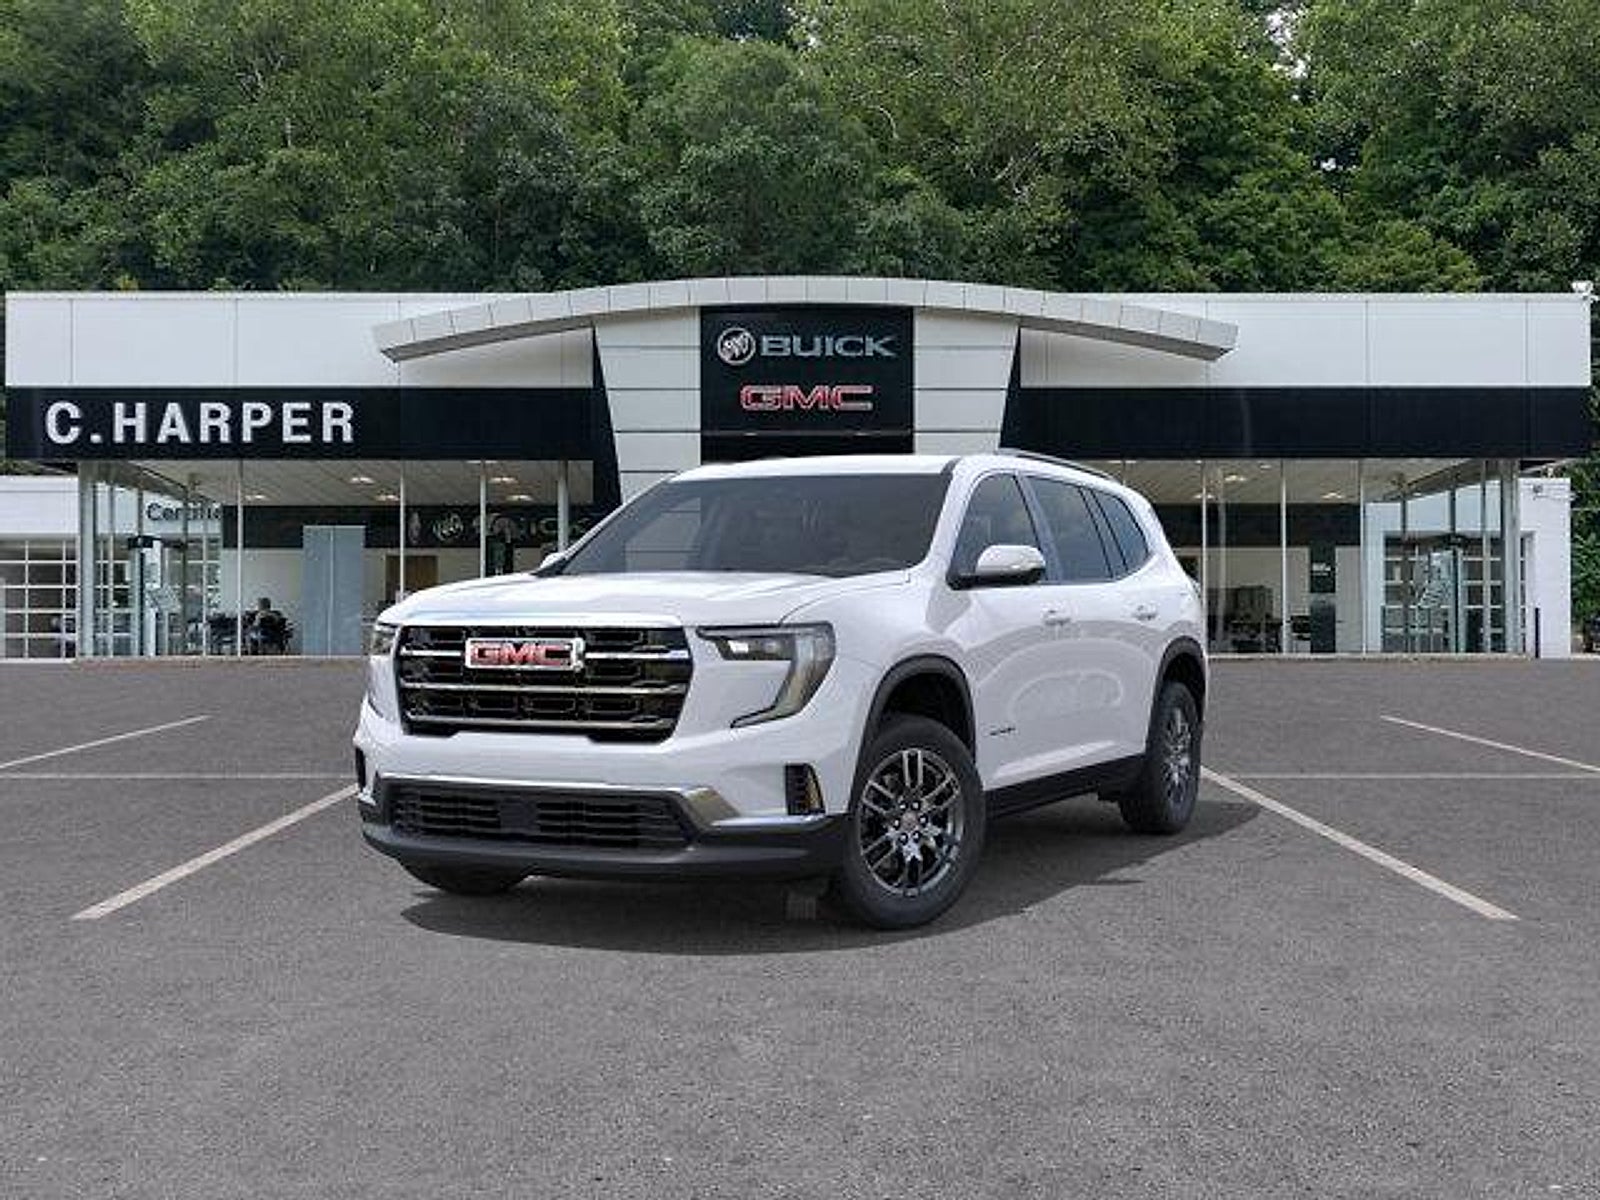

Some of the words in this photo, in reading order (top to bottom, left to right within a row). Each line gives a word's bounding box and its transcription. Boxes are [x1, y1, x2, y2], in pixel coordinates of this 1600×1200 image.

[760, 335, 898, 357] BUICK
[741, 385, 873, 411] GMC
[471, 641, 571, 666] GMC
